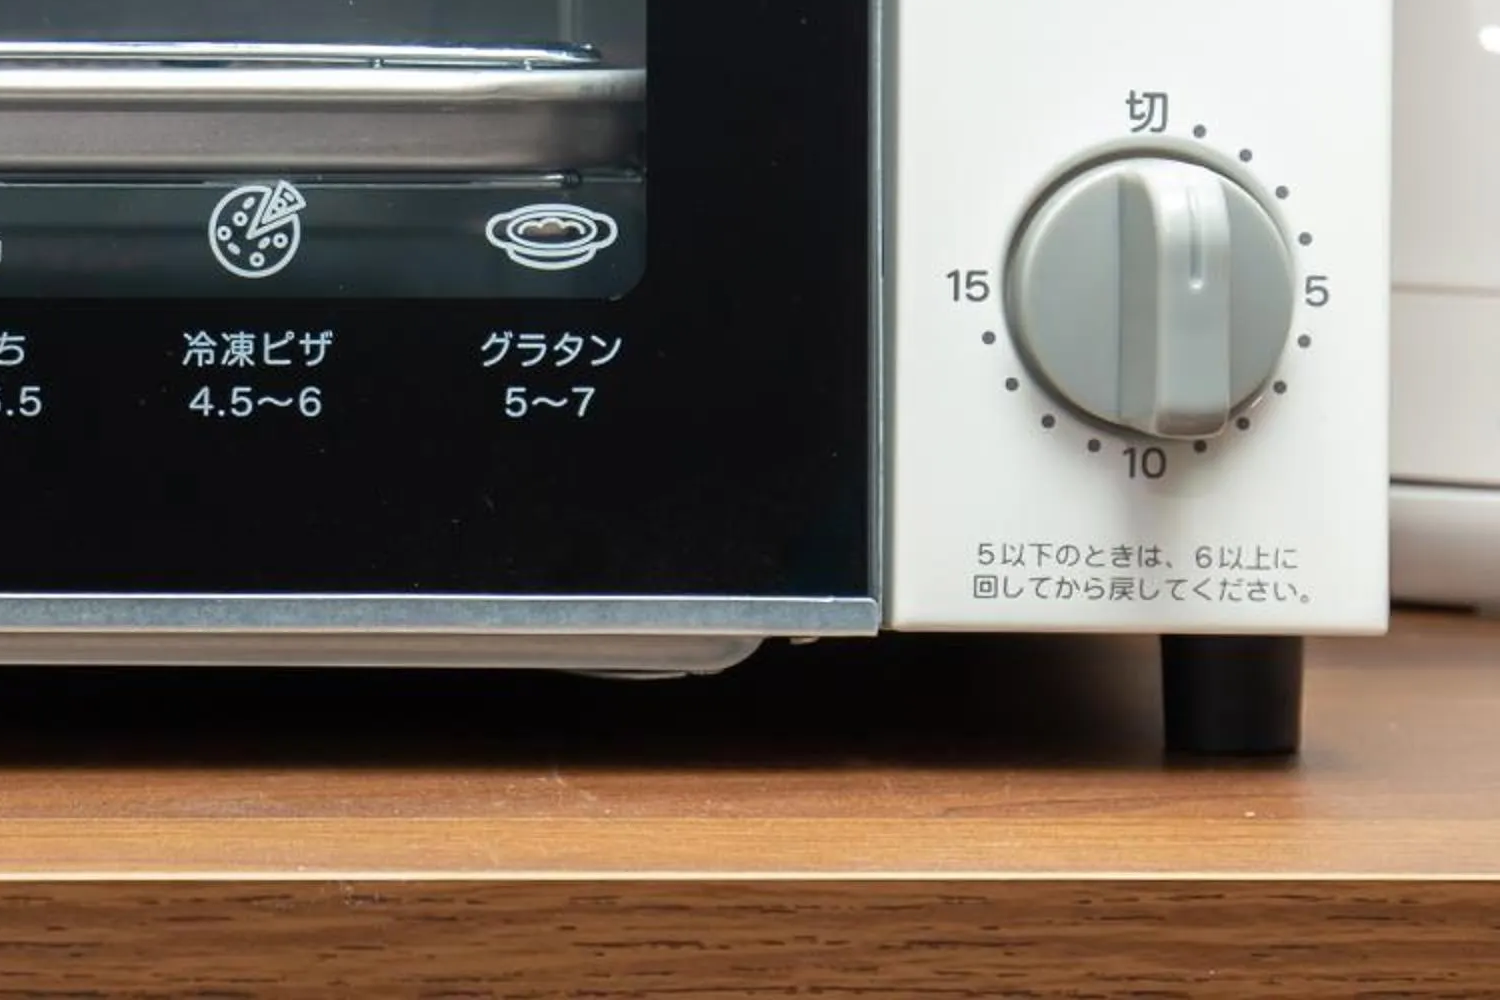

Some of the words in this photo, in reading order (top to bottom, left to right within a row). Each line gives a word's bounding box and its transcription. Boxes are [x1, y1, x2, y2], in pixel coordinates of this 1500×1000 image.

[1124, 89, 1169, 133] 切
[945, 268, 991, 303] 15
[1304, 274, 1330, 308] 5
[181, 329, 334, 368] 冷凍ピザ
[480, 330, 623, 368] グラタン
[1122, 446, 1167, 479] 10
[973, 574, 1312, 604] 回してから戻してください。
